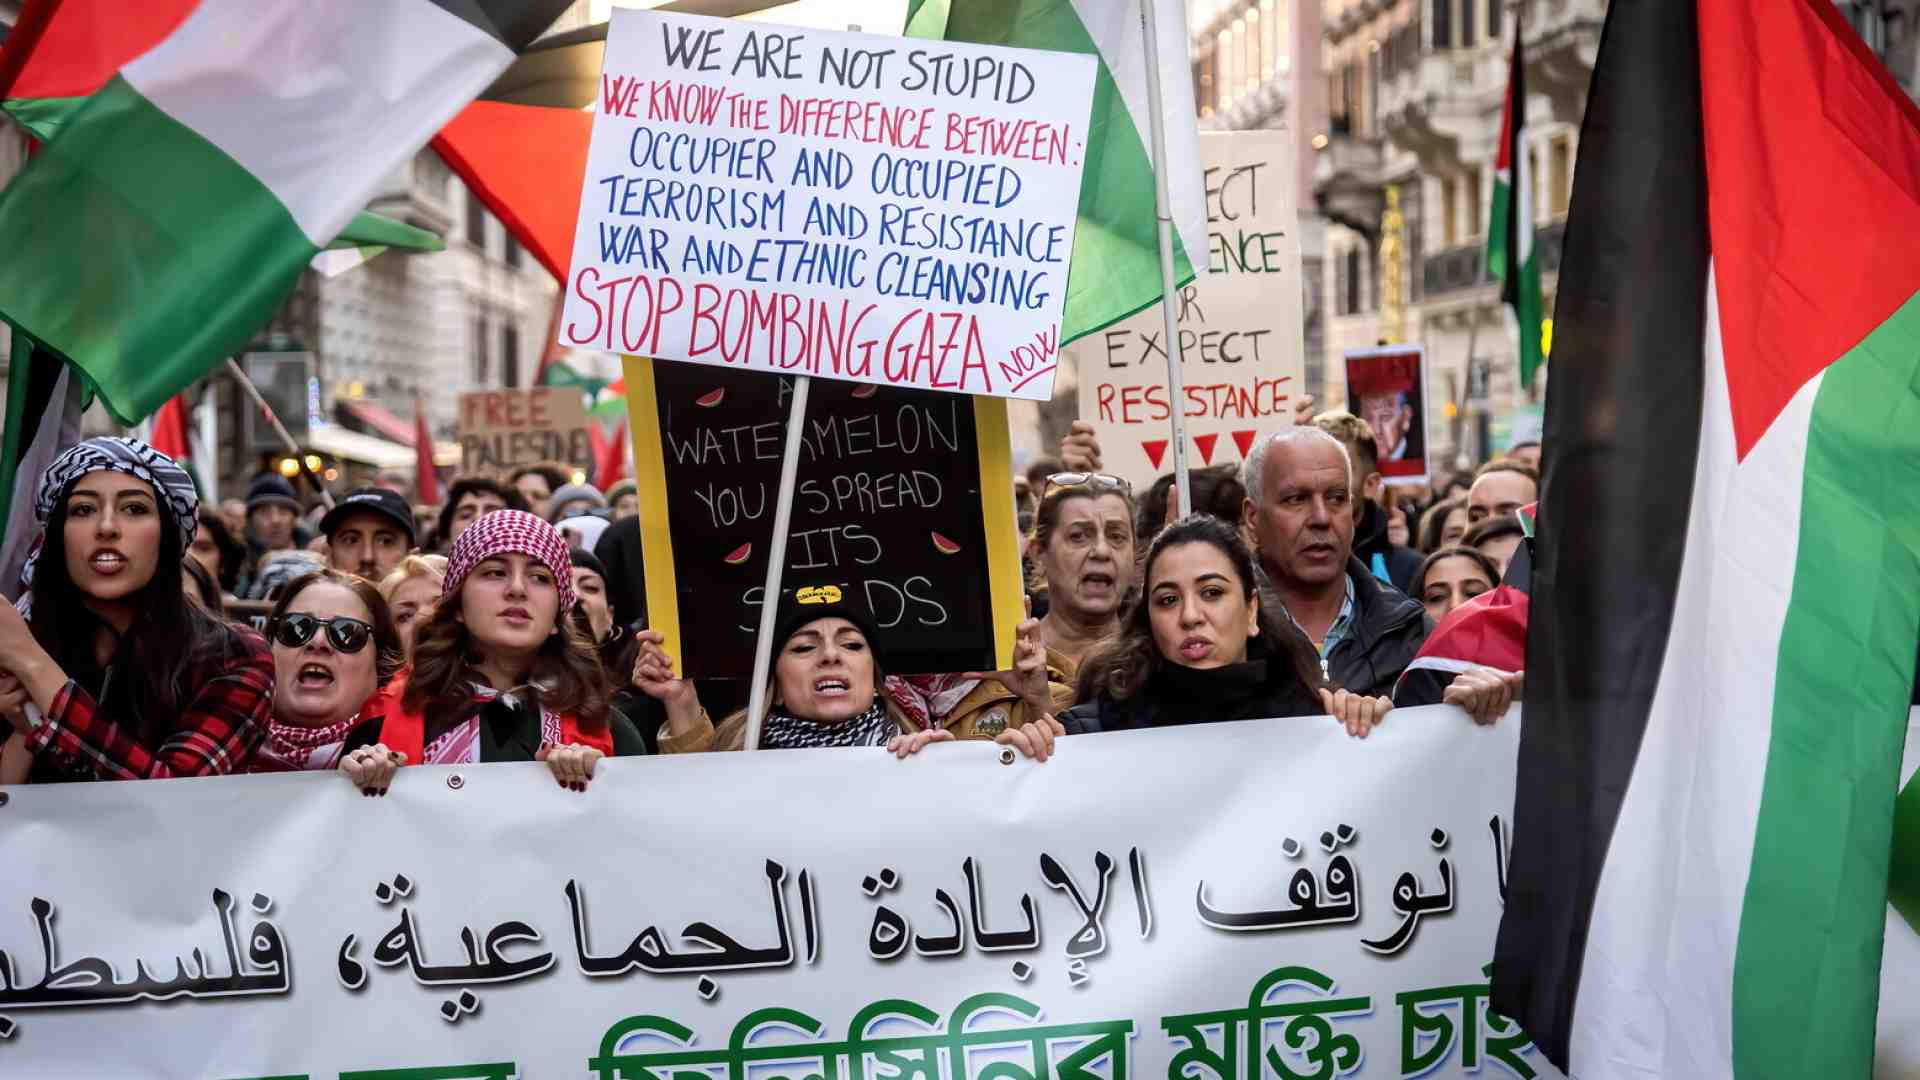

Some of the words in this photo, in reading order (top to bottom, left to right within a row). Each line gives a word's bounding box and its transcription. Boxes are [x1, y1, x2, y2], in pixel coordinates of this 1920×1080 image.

[663, 22, 725, 72] WE
[731, 30, 804, 79] ARE
[819, 48, 895, 90] NOT
[901, 50, 1036, 104] STUPID
[602, 73, 645, 120] WE
[648, 79, 727, 127] KNOW
[726, 93, 768, 131] THE
[779, 93, 935, 149] DIFFERENCE
[630, 127, 777, 183] OCCUPIER
[792, 148, 853, 190] AND
[872, 153, 1022, 208] OCCUPIED
[600, 175, 786, 232] TERRORISM
[803, 197, 868, 240] AND
[879, 204, 1065, 263] RESISTANCE
[600, 222, 670, 273] WAR
[682, 236, 743, 275] AND
[746, 239, 866, 289] ETHNIC
[876, 252, 1050, 310] CLEANSING
[567, 266, 683, 355] STOP
[688, 284, 878, 376] BOMBING
[883, 307, 993, 393] GAZA
[998, 324, 1057, 382] NOW
[1105, 329, 1271, 368] EXPECT
[464, 389, 552, 427] FREE
[1097, 376, 1292, 423] RESSTANCE
[694, 482, 765, 527] YOU
[800, 471, 942, 514] SPREAD
[791, 525, 882, 568] ITS
[739, 576, 947, 632] SDS
[862, 846, 1153, 986] الإبادة
[1196, 822, 1458, 954] نوقف
[335, 858, 820, 1021] الجماعية،
